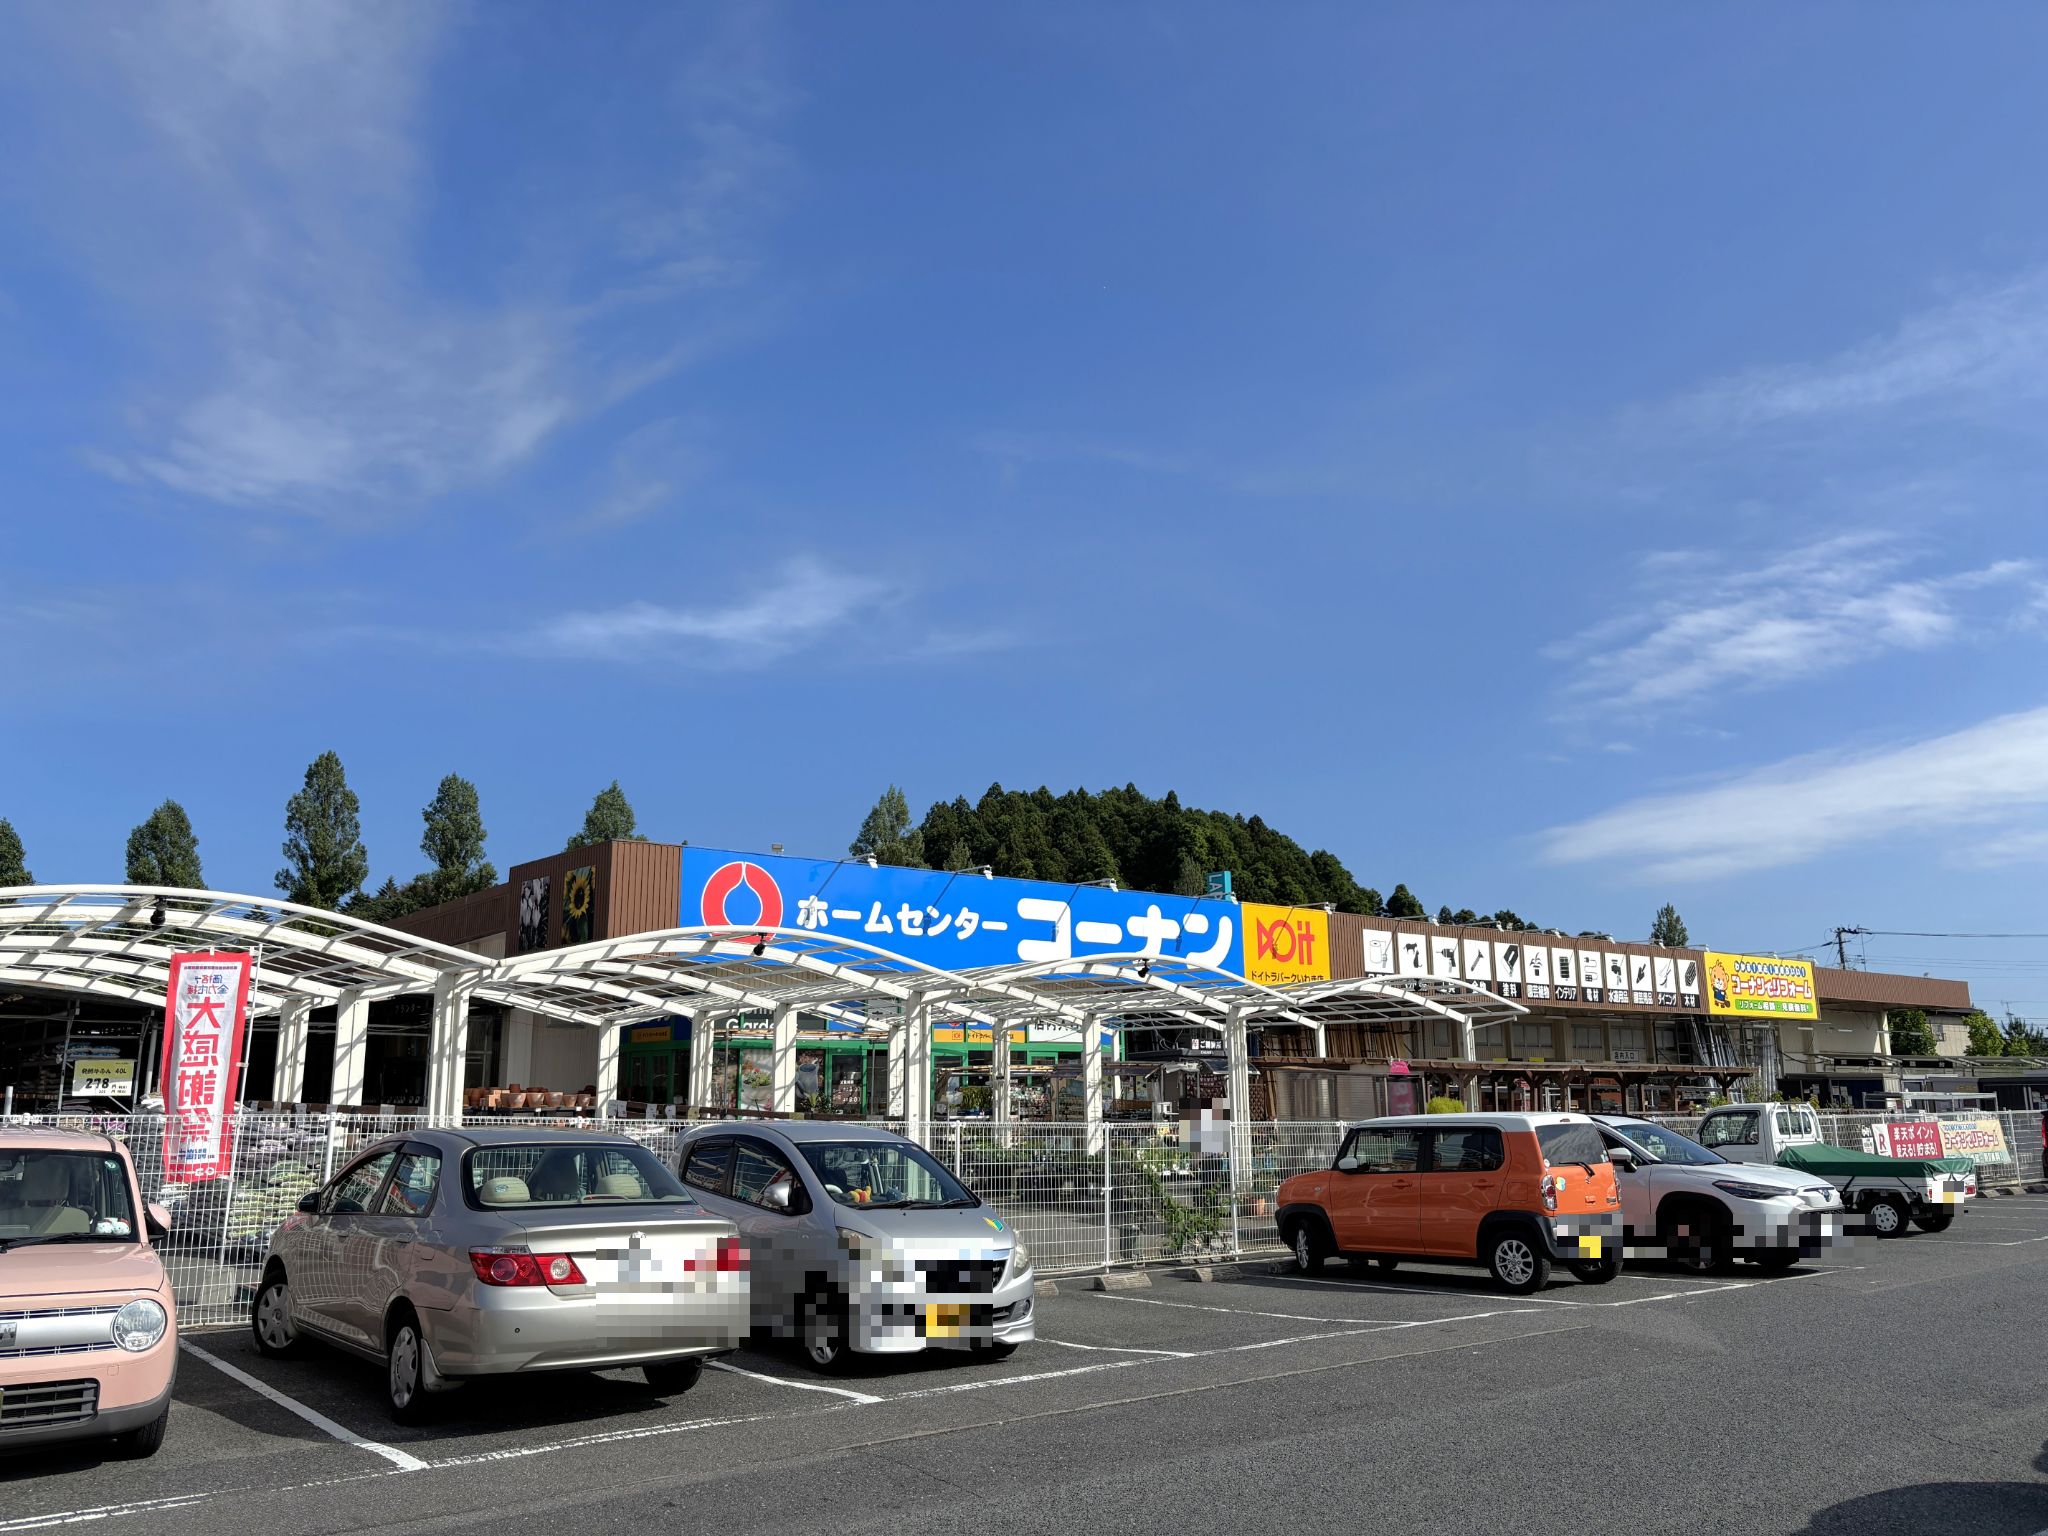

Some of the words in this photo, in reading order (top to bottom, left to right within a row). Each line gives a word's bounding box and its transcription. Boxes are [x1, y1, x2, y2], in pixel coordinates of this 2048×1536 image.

[796, 895, 1008, 940] ホームセンター
[1016, 898, 1233, 970] コーナン
[1502, 982, 1517, 997] 塗料
[1555, 986, 1577, 1000] インテリア
[1731, 974, 1813, 999] コーナンでリフォーム
[1684, 994, 1695, 1007] 木材
[85, 1078, 110, 1089] 278
[1893, 1124, 1934, 1141] 楽天ポイント
[1878, 1133, 1887, 1150] R
